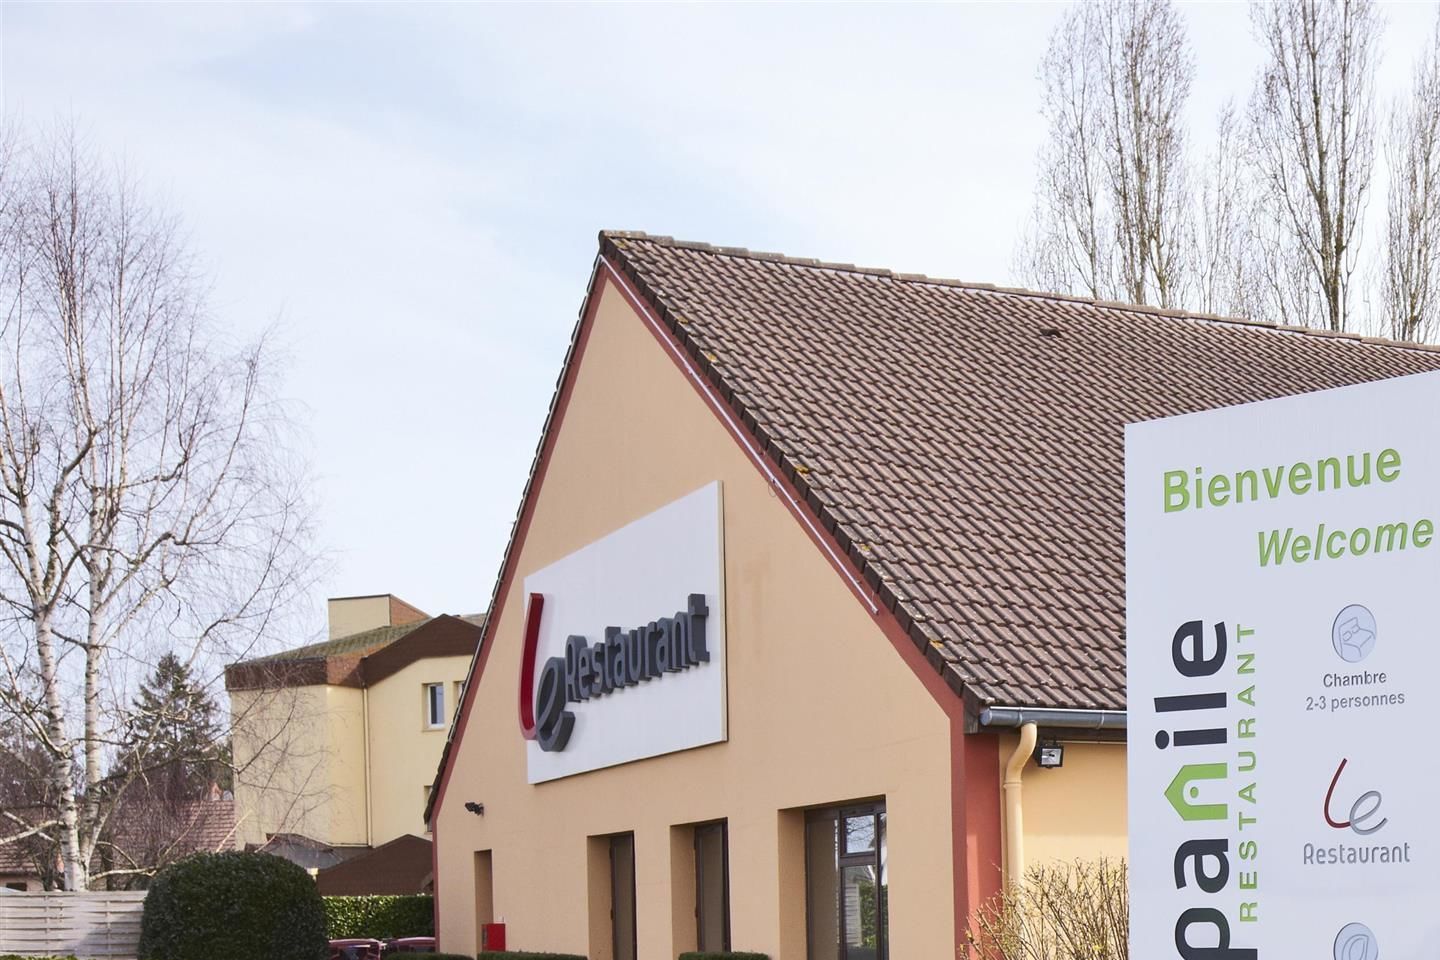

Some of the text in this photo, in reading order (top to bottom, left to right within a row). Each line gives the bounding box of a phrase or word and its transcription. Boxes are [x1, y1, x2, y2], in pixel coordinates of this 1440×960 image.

[1163, 447, 1402, 513] Bienvenue
[1257, 518, 1435, 567] Welcome
[565, 593, 711, 703] Restaurant
[1305, 692, 1406, 712] 2-3 personnes
[1323, 671, 1387, 688] Chambre
[1236, 623, 1258, 922] RESTAURANT
[1303, 842, 1411, 865] Restaurant
